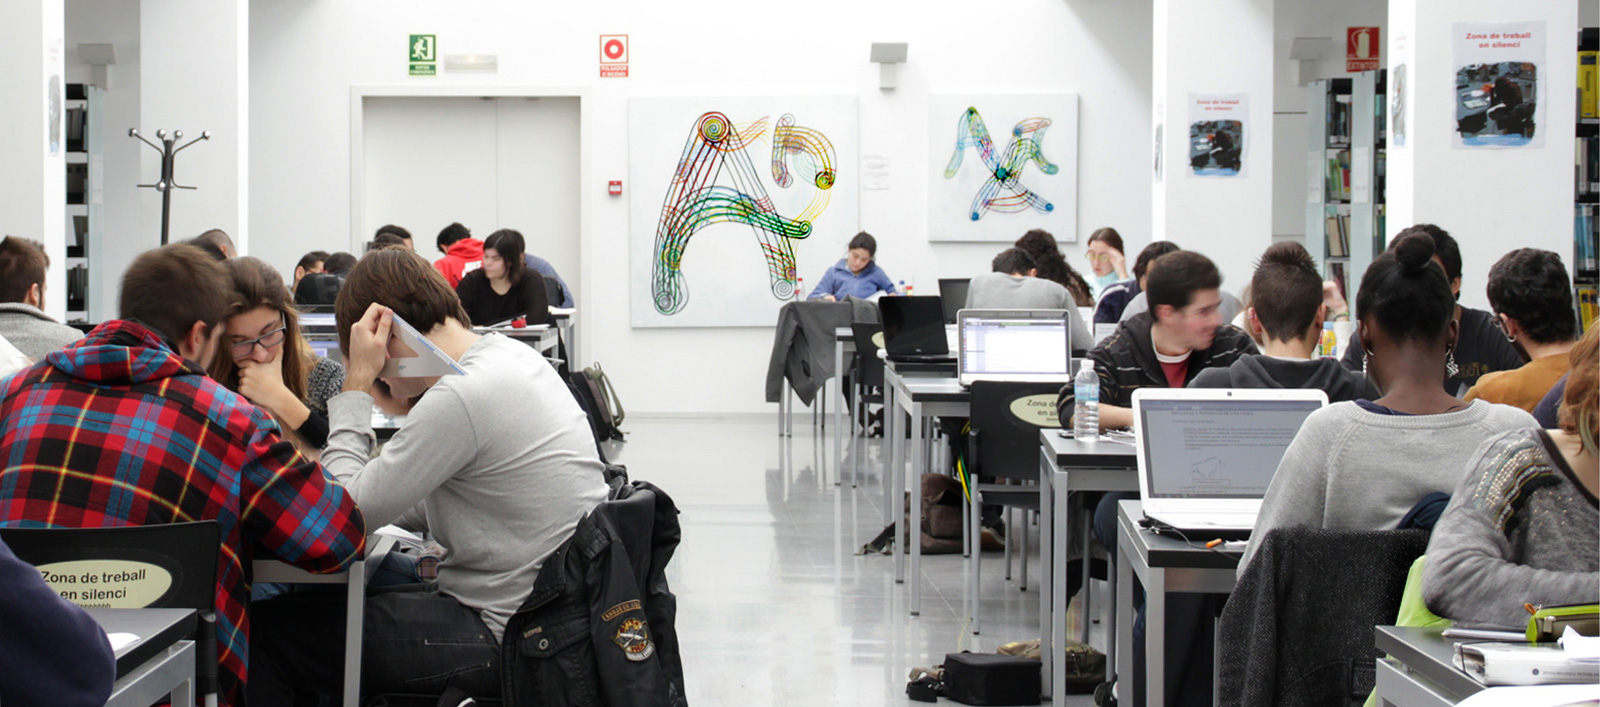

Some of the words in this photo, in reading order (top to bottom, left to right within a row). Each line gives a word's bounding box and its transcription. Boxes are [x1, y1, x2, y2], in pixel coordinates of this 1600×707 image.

[41, 571, 77, 583] Zona
[81, 572, 98, 584] de
[103, 569, 146, 583] treball
[60, 590, 78, 600] en
[82, 587, 127, 600] silenci
